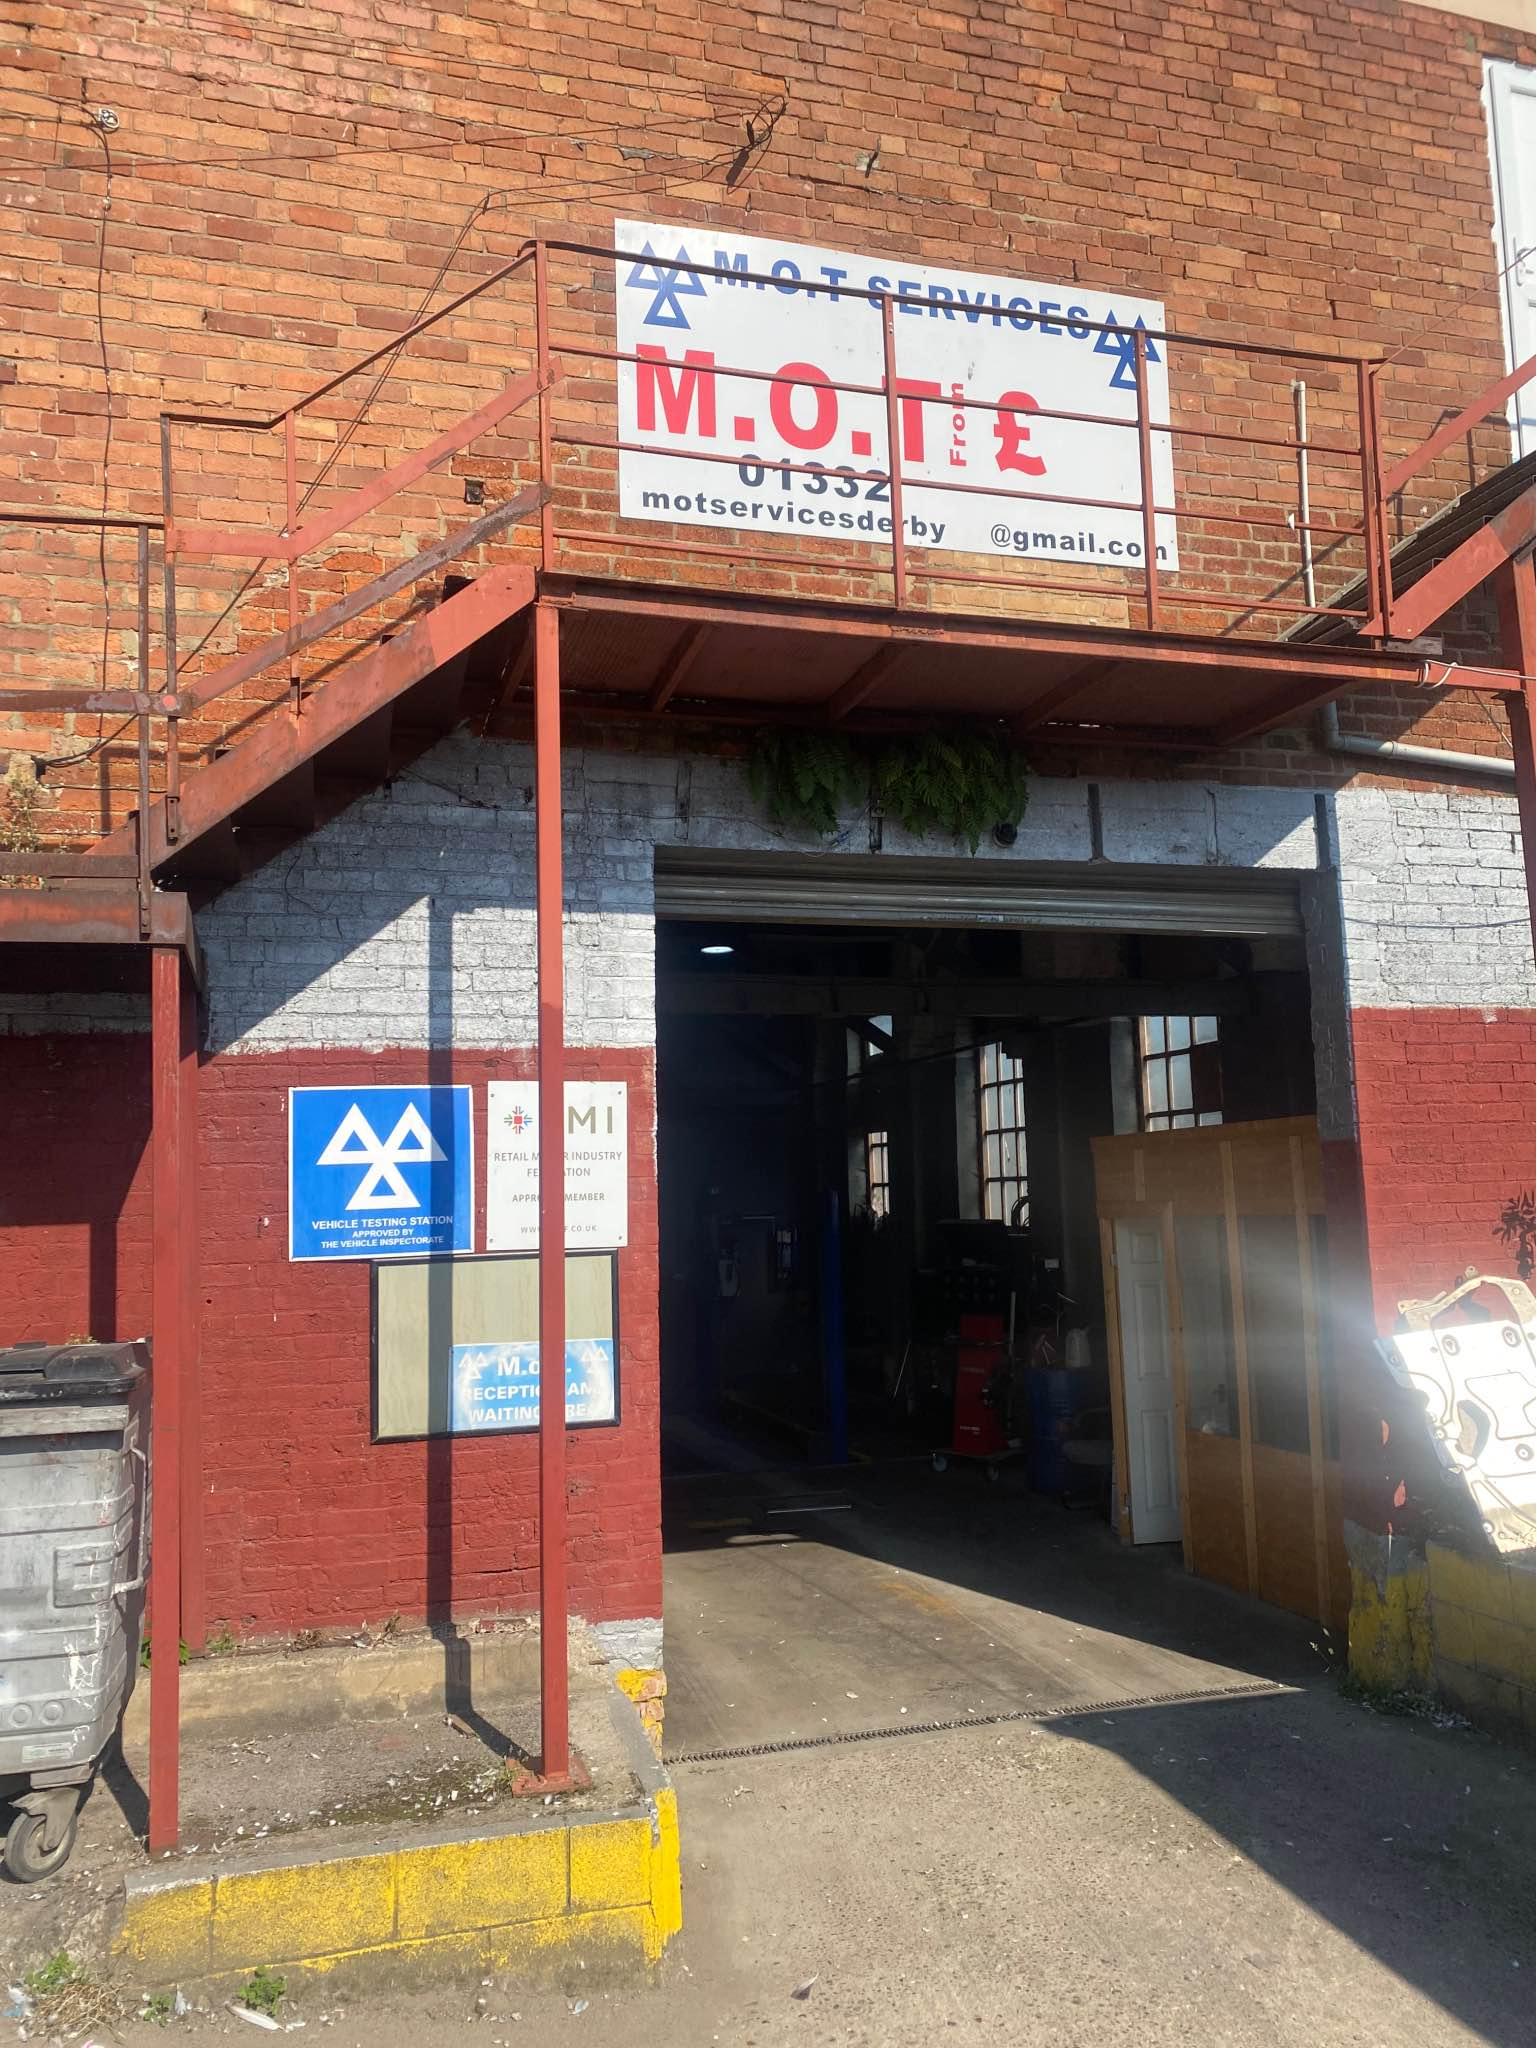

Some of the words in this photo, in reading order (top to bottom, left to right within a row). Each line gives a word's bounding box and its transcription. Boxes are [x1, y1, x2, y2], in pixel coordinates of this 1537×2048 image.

[714, 250, 847, 302] M.O.T
[868, 276, 1088, 339] SERVICES
[636, 344, 941, 463] M.O.T
[950, 383, 967, 466] From
[994, 391, 1047, 475] £
[738, 454, 889, 502] 01332
[494, 1152, 528, 1162] RETAIL
[572, 1151, 622, 1160] INDUSTRY
[564, 1193, 605, 1201] MEMBER
[312, 1219, 358, 1230] VEHICLE
[362, 1217, 407, 1228] TESTING
[410, 1215, 453, 1226] STATION
[352, 1229, 399, 1238] APPROVED
[402, 1228, 413, 1236] BY
[320, 1241, 338, 1249] THE
[341, 1239, 377, 1247] VEHICLE
[380, 1236, 444, 1246] INSPECTORATE
